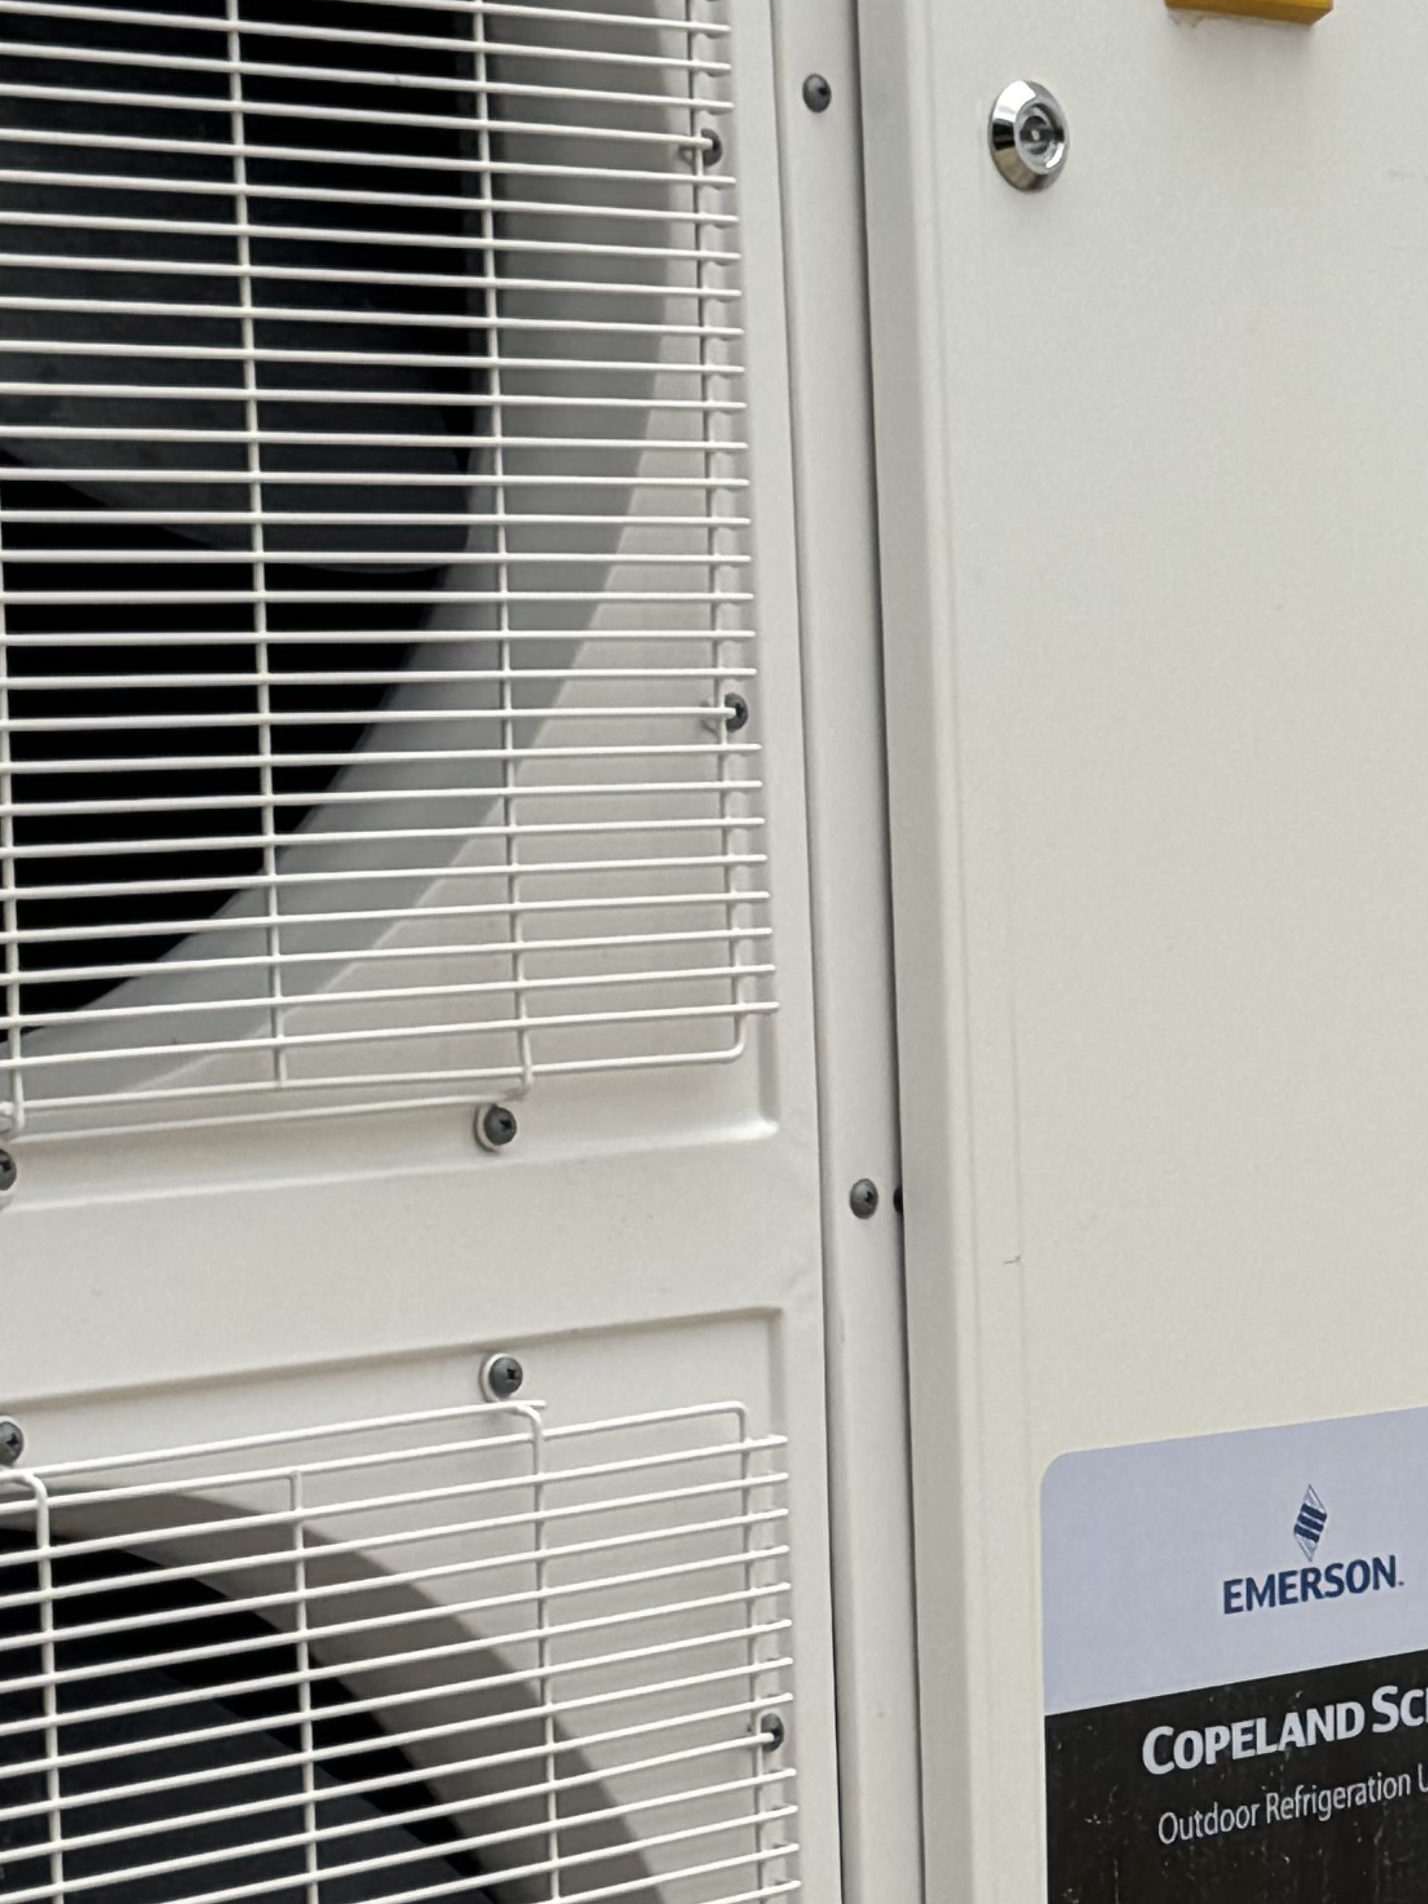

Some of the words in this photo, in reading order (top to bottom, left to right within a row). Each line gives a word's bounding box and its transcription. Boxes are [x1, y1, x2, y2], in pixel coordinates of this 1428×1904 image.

[1141, 1701, 1365, 1775] COPELAND
[1158, 1802, 1260, 1845] Outdoor
[1265, 1771, 1411, 1824] Refrigeration
